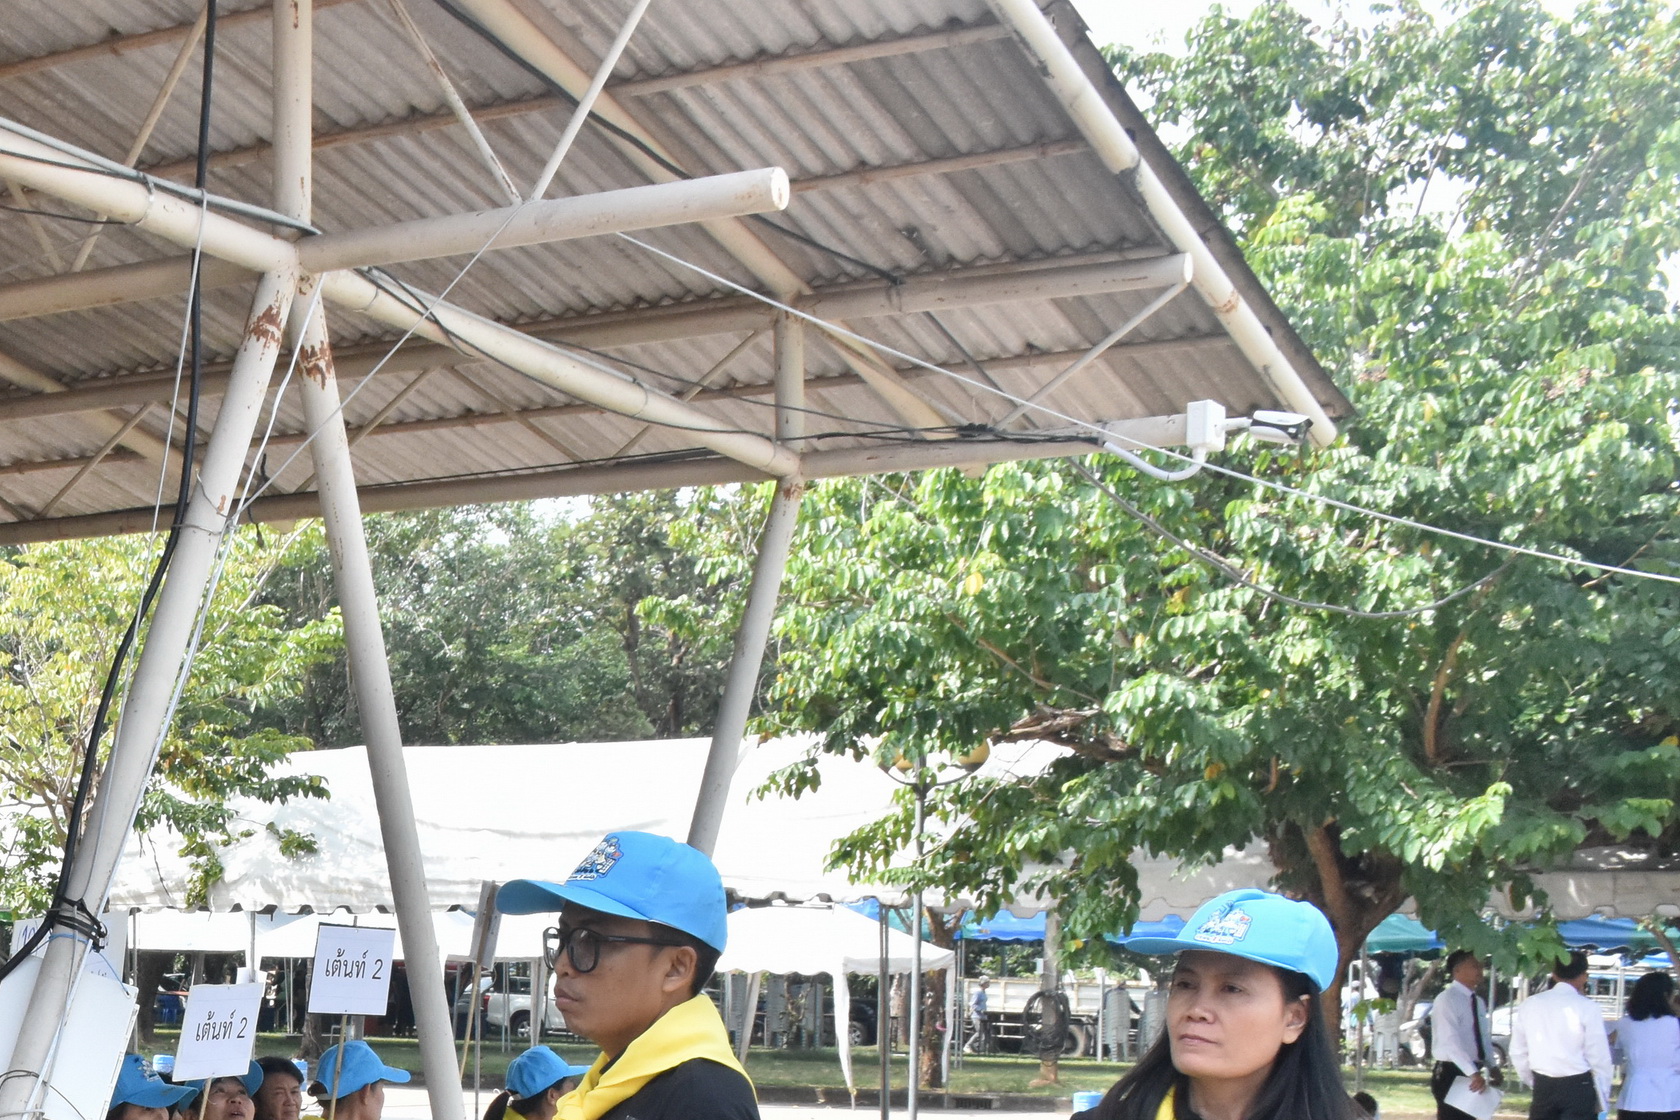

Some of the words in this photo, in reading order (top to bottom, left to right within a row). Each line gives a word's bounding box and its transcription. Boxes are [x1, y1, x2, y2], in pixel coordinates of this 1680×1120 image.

[325, 947, 369, 979] เต้นท์
[371, 958, 384, 980] 2
[195, 1008, 237, 1042] เต้นท์
[236, 1016, 248, 1039] 2
